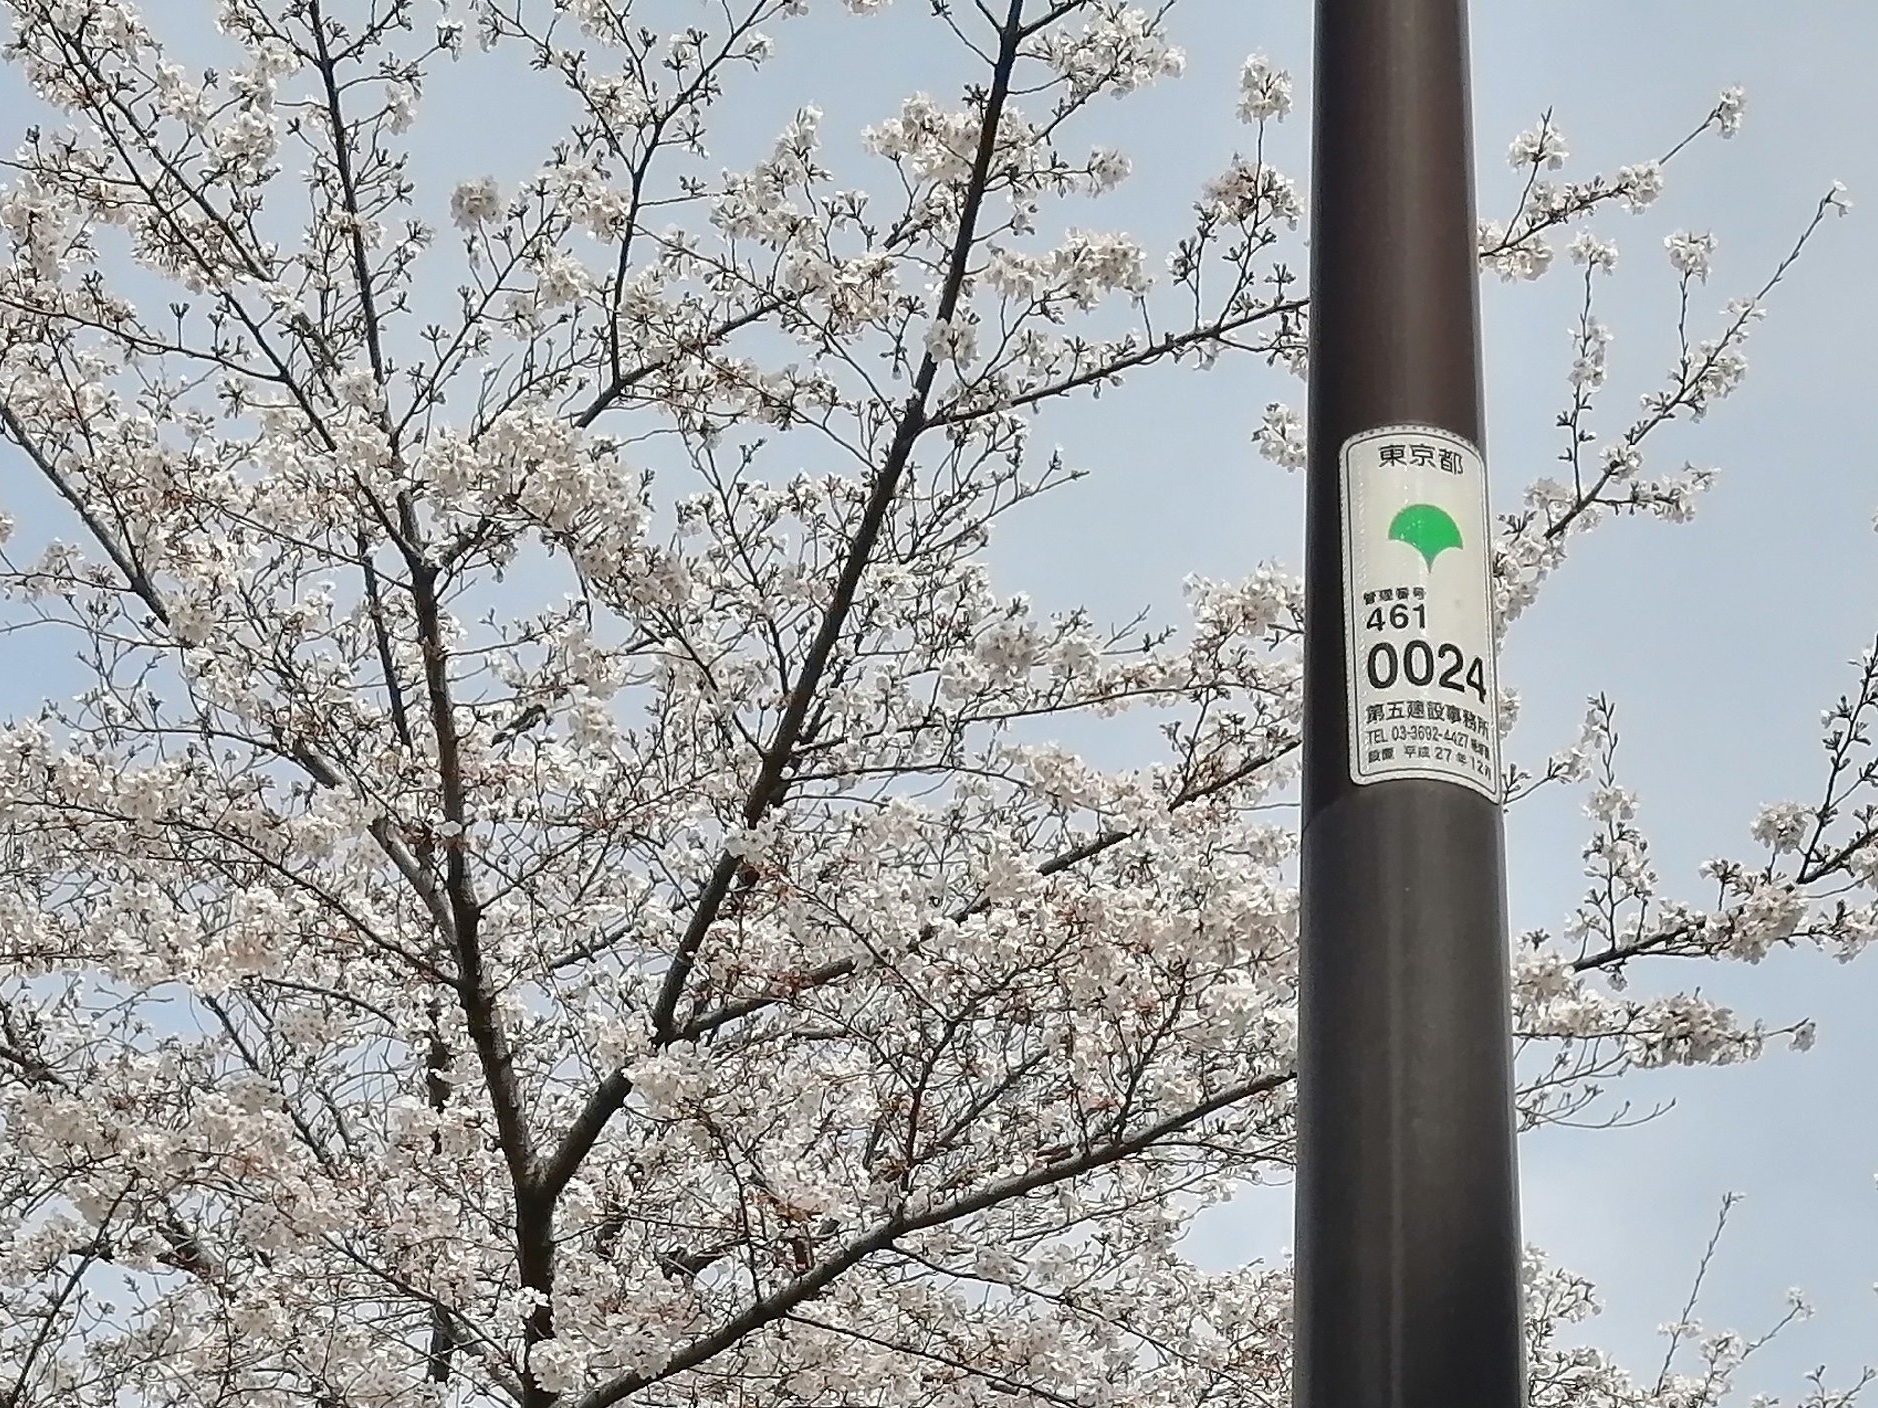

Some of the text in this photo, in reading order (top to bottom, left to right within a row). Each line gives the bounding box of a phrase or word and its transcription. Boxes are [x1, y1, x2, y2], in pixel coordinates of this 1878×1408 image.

[1378, 443, 1465, 477] 東京都
[1366, 603, 1427, 632] 461
[1366, 639, 1487, 705] 0024
[1365, 728, 1388, 745] TEL
